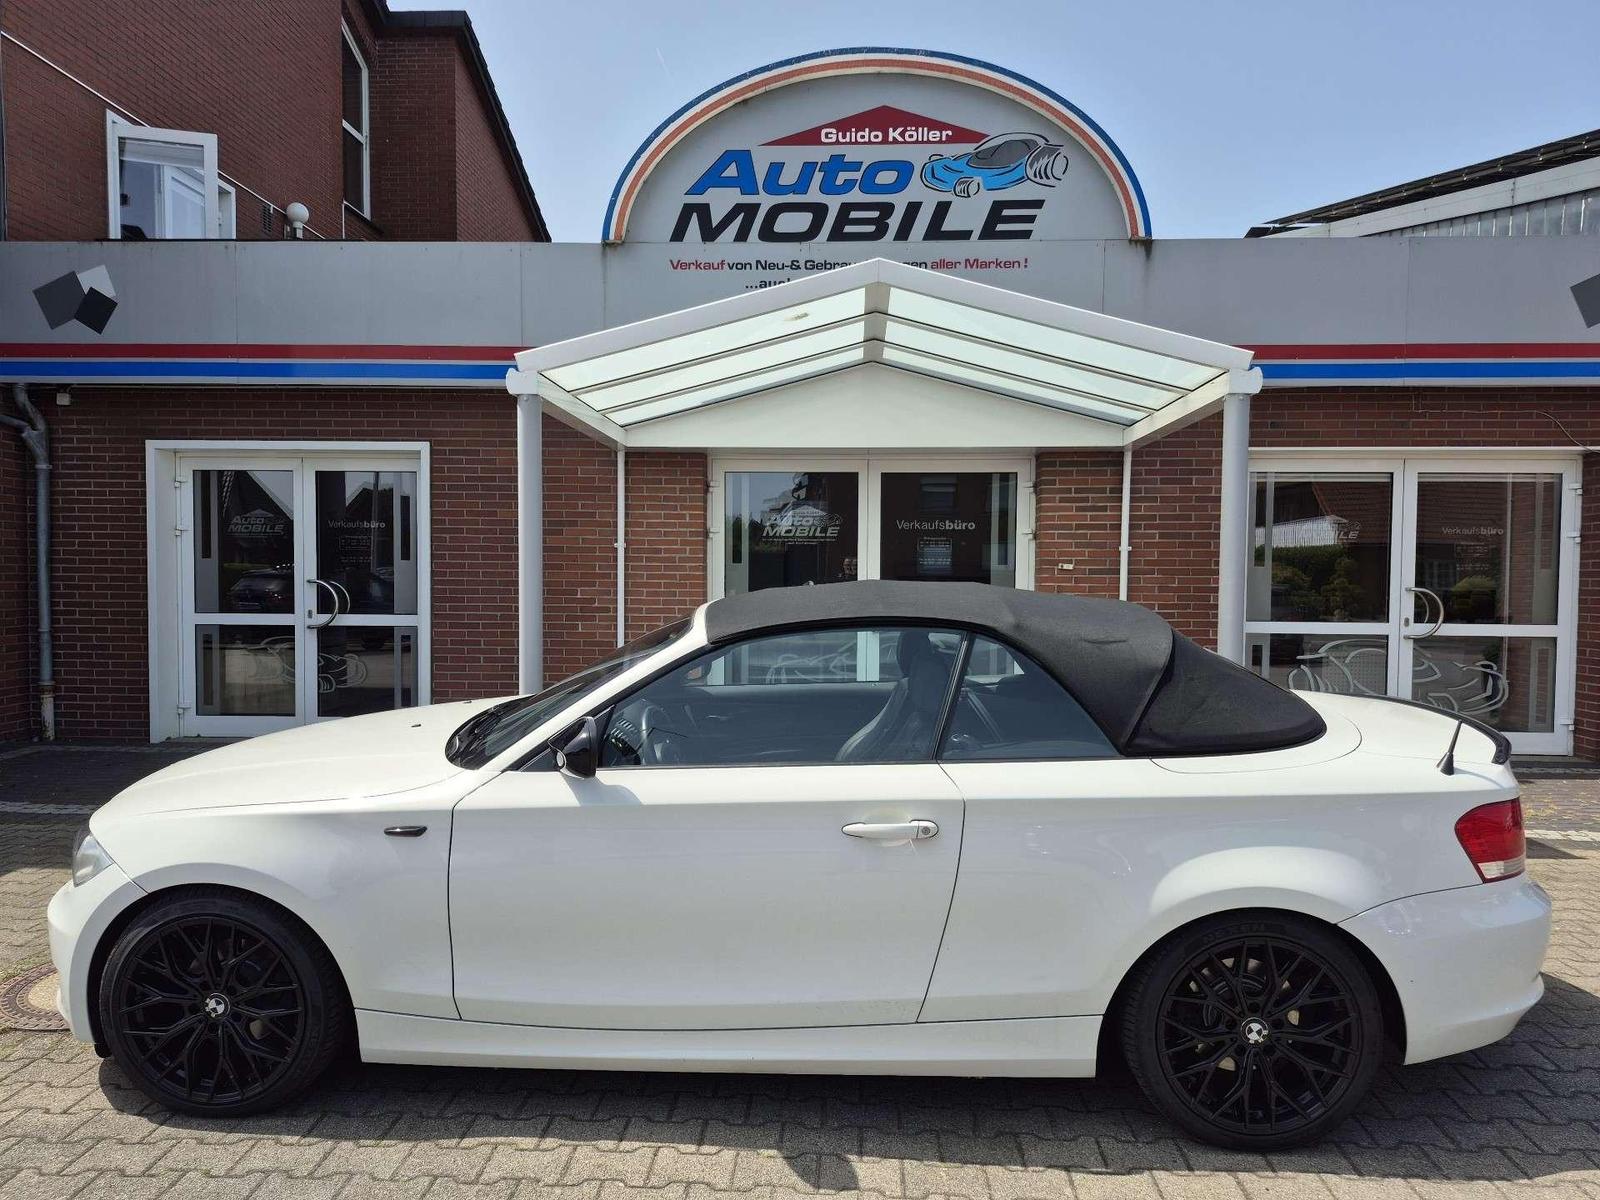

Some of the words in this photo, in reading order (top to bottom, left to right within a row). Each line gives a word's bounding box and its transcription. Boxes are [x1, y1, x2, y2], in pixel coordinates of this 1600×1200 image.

[820, 127, 883, 143] Guido
[887, 126, 953, 143] Köller
[684, 149, 915, 196] Auto
[669, 199, 1046, 243] MOBILE
[669, 259, 726, 271] Verkauf
[727, 261, 753, 271] von
[930, 258, 962, 270] aller
[227, 524, 285, 533] MOBILE
[327, 519, 386, 529] Verkaufsbüro
[896, 519, 976, 530] Verkaufsbüro
[762, 526, 840, 537] MOBILE
[1441, 526, 1504, 535] Verkaufsbüro
